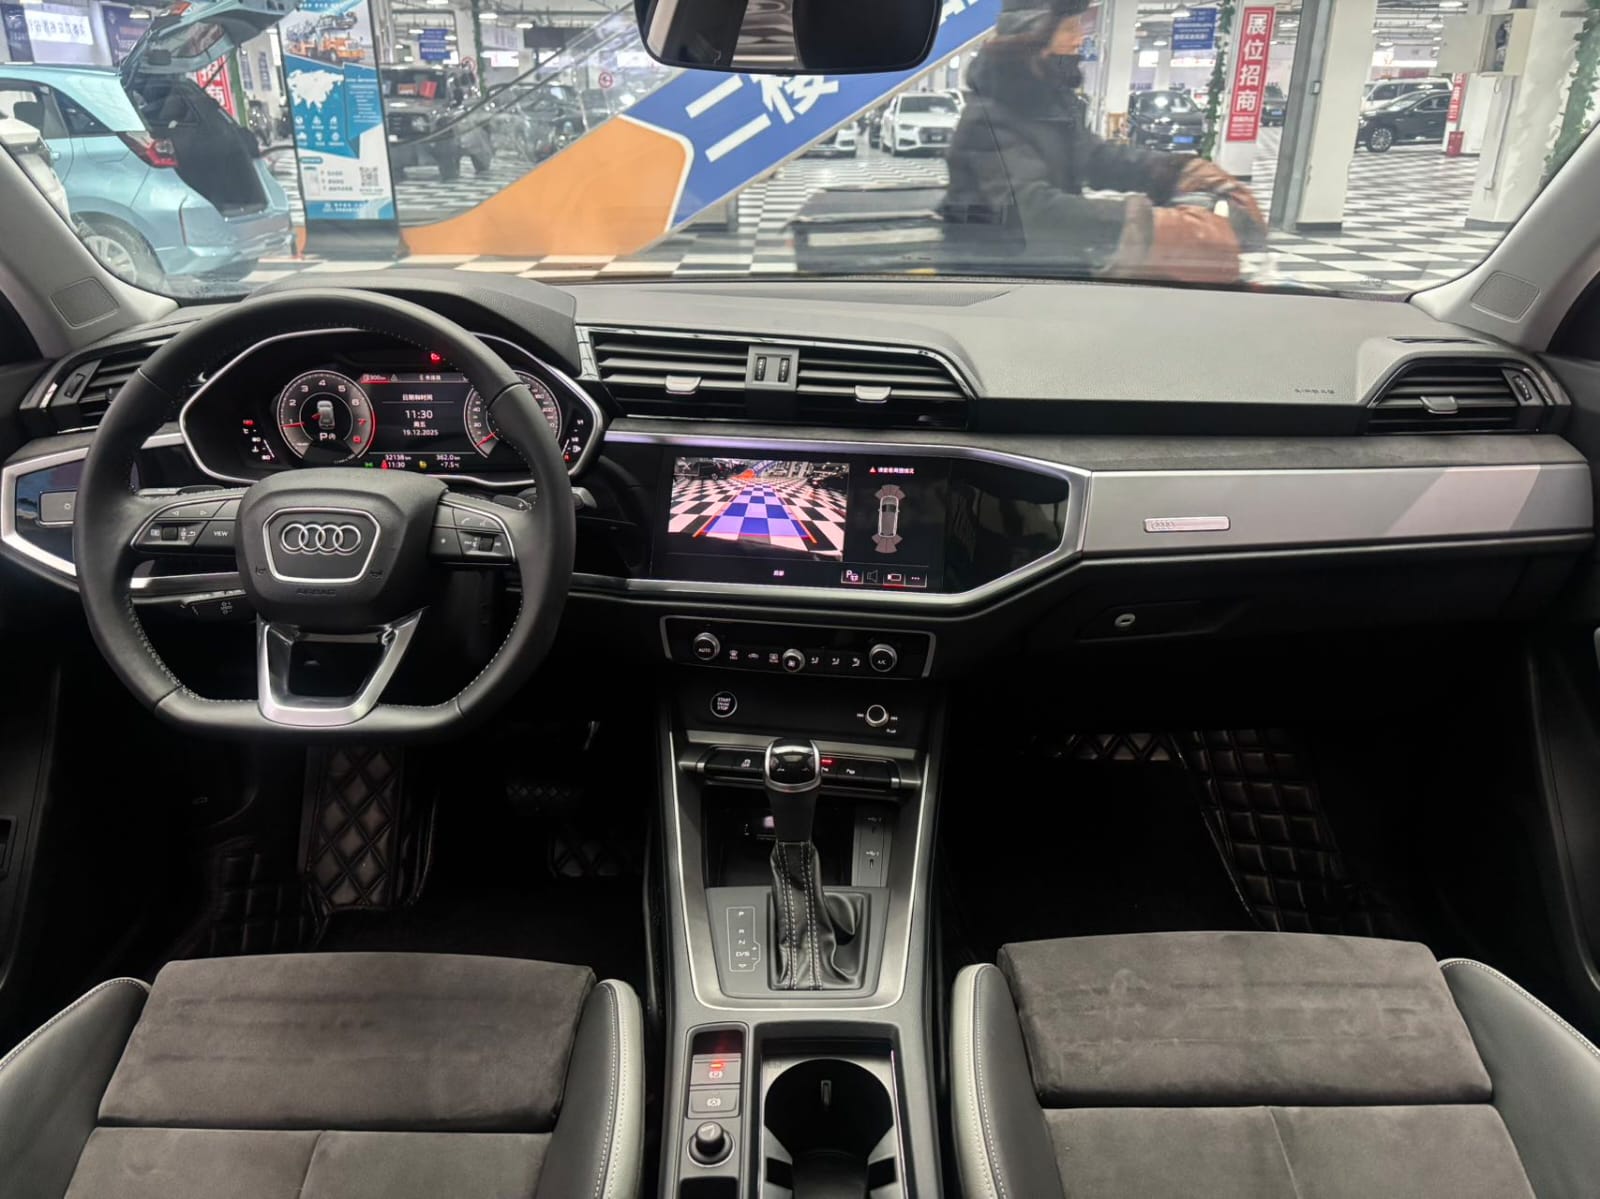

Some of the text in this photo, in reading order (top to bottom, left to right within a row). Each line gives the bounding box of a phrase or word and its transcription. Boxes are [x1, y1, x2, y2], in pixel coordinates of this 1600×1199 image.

[1235, 13, 1268, 112] 展位招商
[351, 398, 360, 406] 6
[405, 410, 434, 419] 11:30
[319, 432, 328, 440] P
